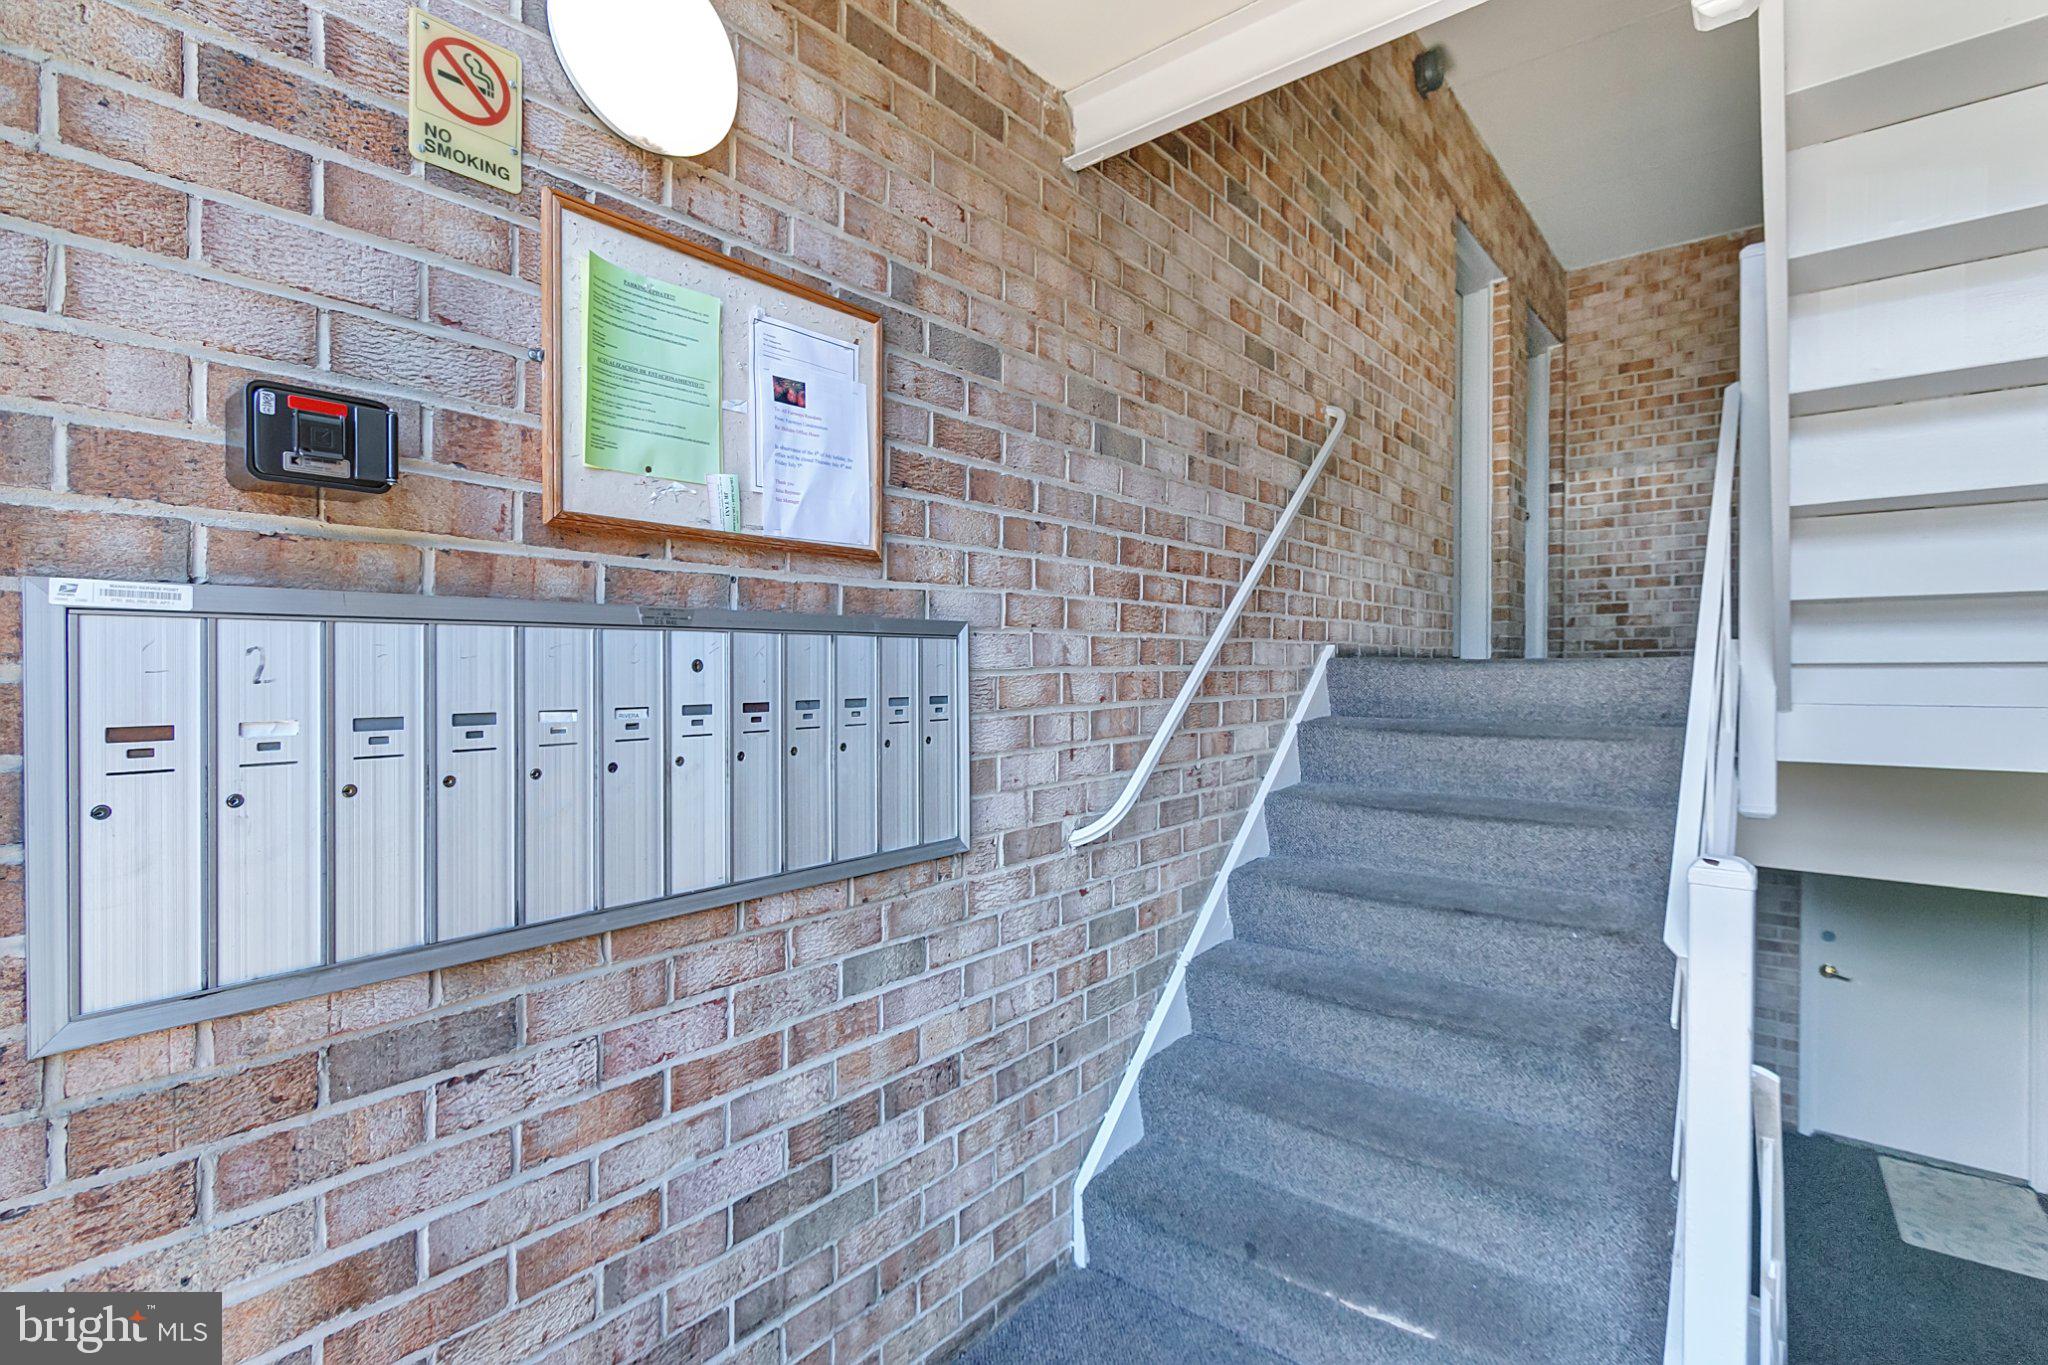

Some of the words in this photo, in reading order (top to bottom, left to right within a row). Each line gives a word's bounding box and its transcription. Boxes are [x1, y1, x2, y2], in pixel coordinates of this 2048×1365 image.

[424, 122, 451, 143] NO
[424, 138, 510, 181] SMOKING
[245, 645, 276, 685] 2
